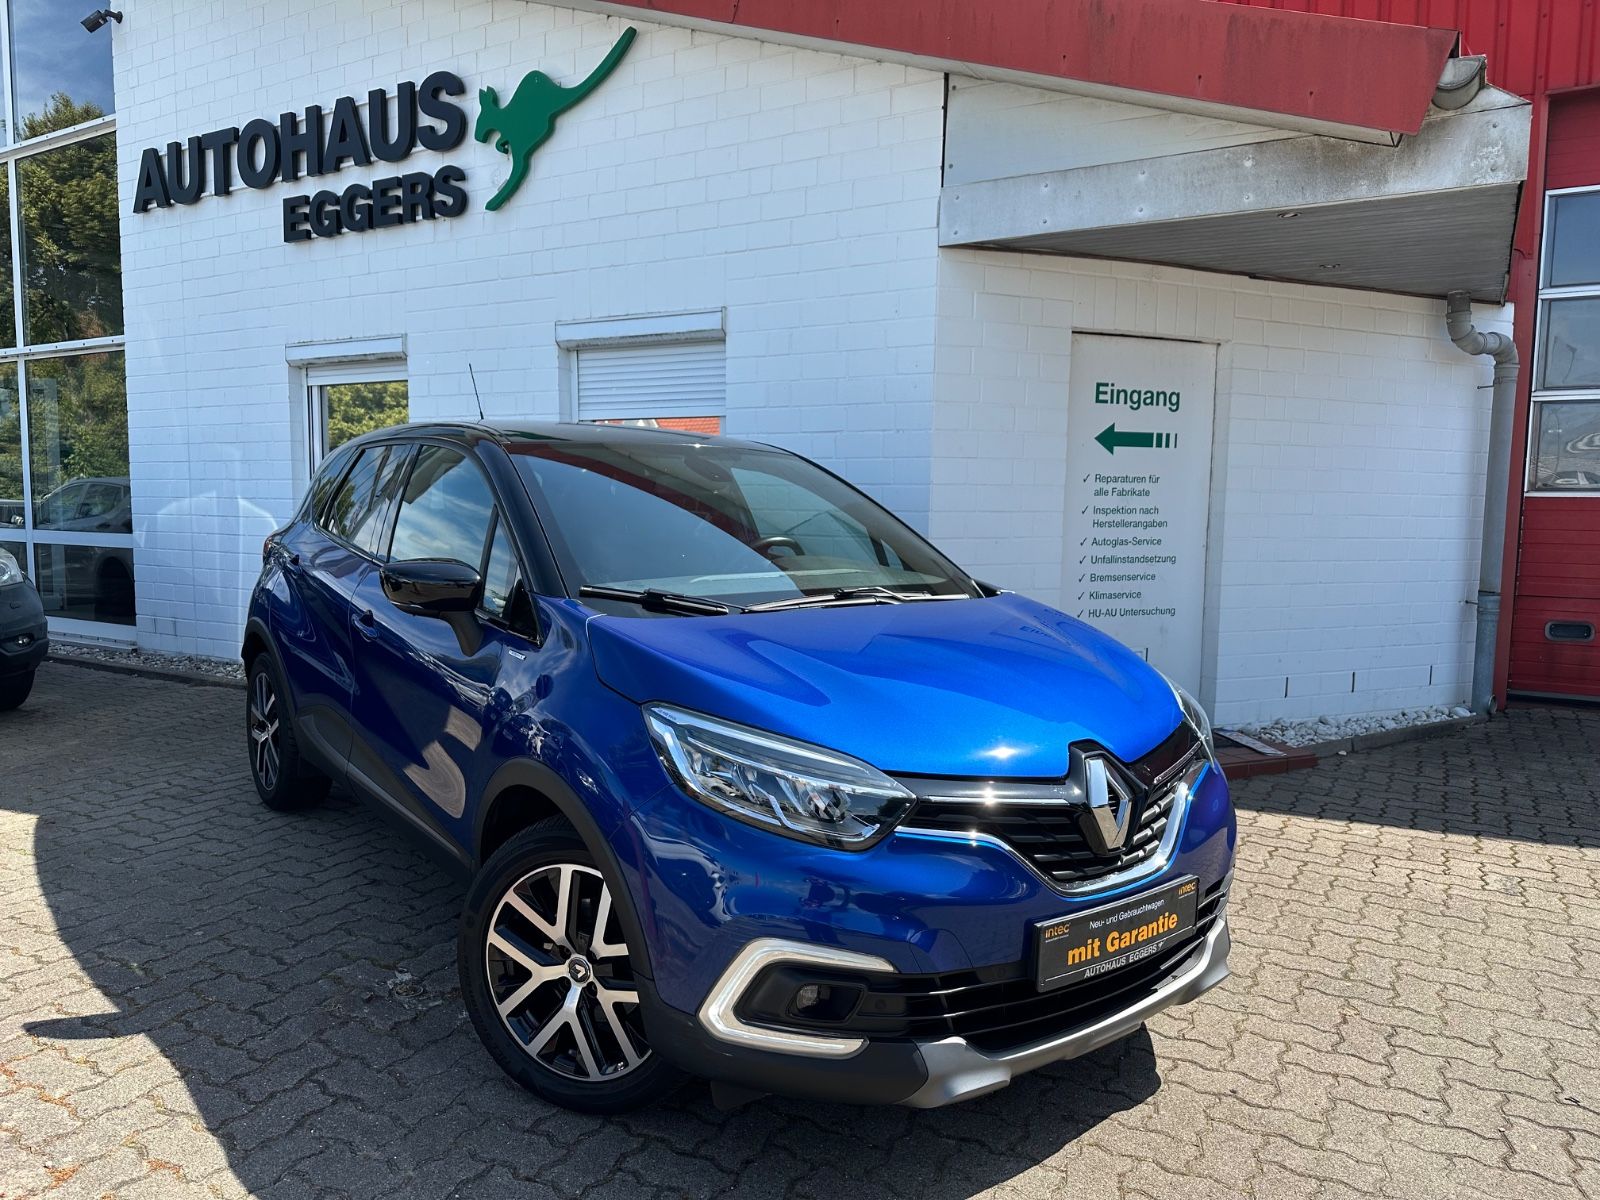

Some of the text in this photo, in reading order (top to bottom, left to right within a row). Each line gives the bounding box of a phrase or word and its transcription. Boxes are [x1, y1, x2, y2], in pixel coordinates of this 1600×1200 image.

[133, 70, 466, 214] AUTOHAUS
[283, 165, 467, 243] EGGERS
[1095, 382, 1181, 412] Eingang
[1094, 473, 1161, 485] Reparaturen für
[1093, 487, 1151, 497] alle Fabrikate
[1092, 505, 1159, 517] Inspektion nach
[1092, 519, 1168, 530] Herstellerangaben
[1091, 537, 1162, 548] Autoglas-Service
[1090, 554, 1177, 565] Unfallinstandsetzung
[1089, 572, 1156, 582] Bremsenservice
[1088, 590, 1142, 600] Klimaservice
[1087, 606, 1176, 618] HU-AU Untersuchung
[1089, 899, 1165, 930] Neu- und Gebrauchtwagen
[1045, 923, 1071, 939] intec
[1067, 911, 1178, 966] mit Garantie
[1084, 944, 1157, 979] AUTOHAUS EGGERS
